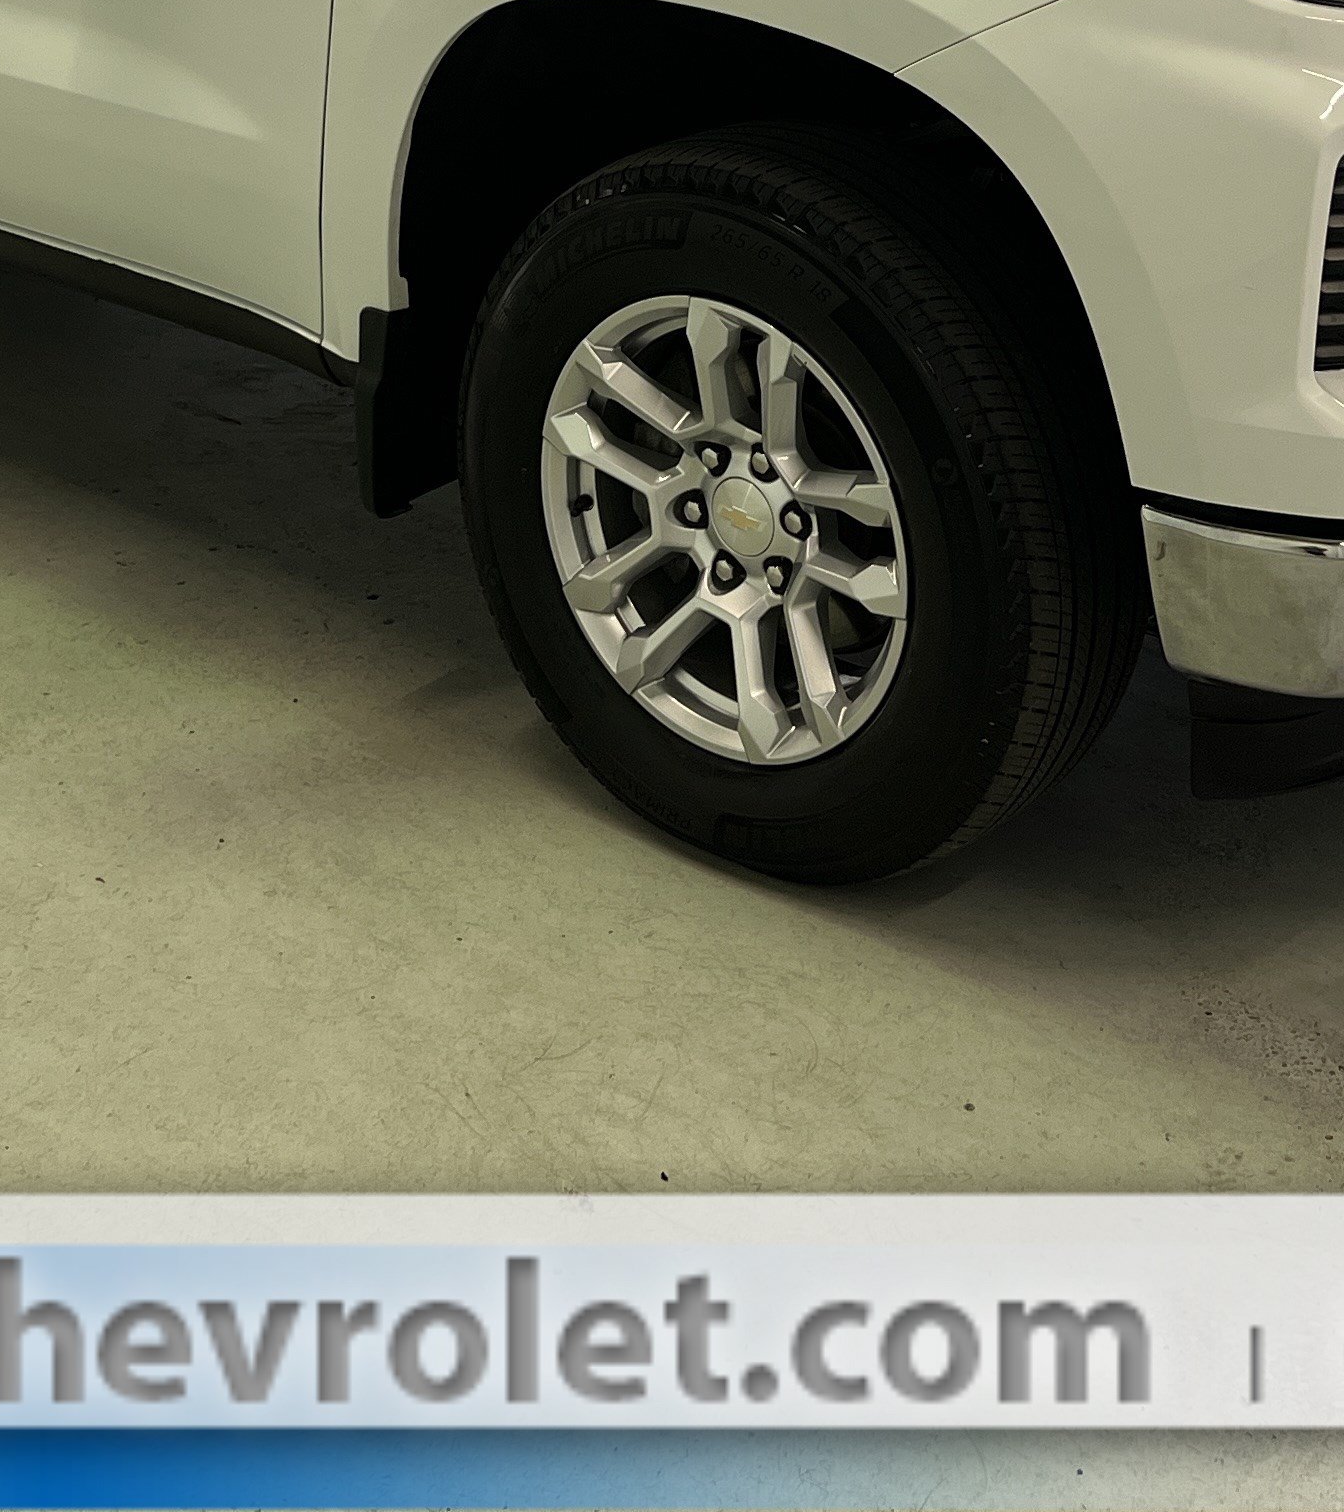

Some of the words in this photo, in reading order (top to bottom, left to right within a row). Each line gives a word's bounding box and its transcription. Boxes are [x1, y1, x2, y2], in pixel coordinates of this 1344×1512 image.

[532, 215, 683, 294] MICHELIN
[709, 223, 784, 269] 265/65
[787, 262, 806, 282] R
[808, 280, 833, 304] 18
